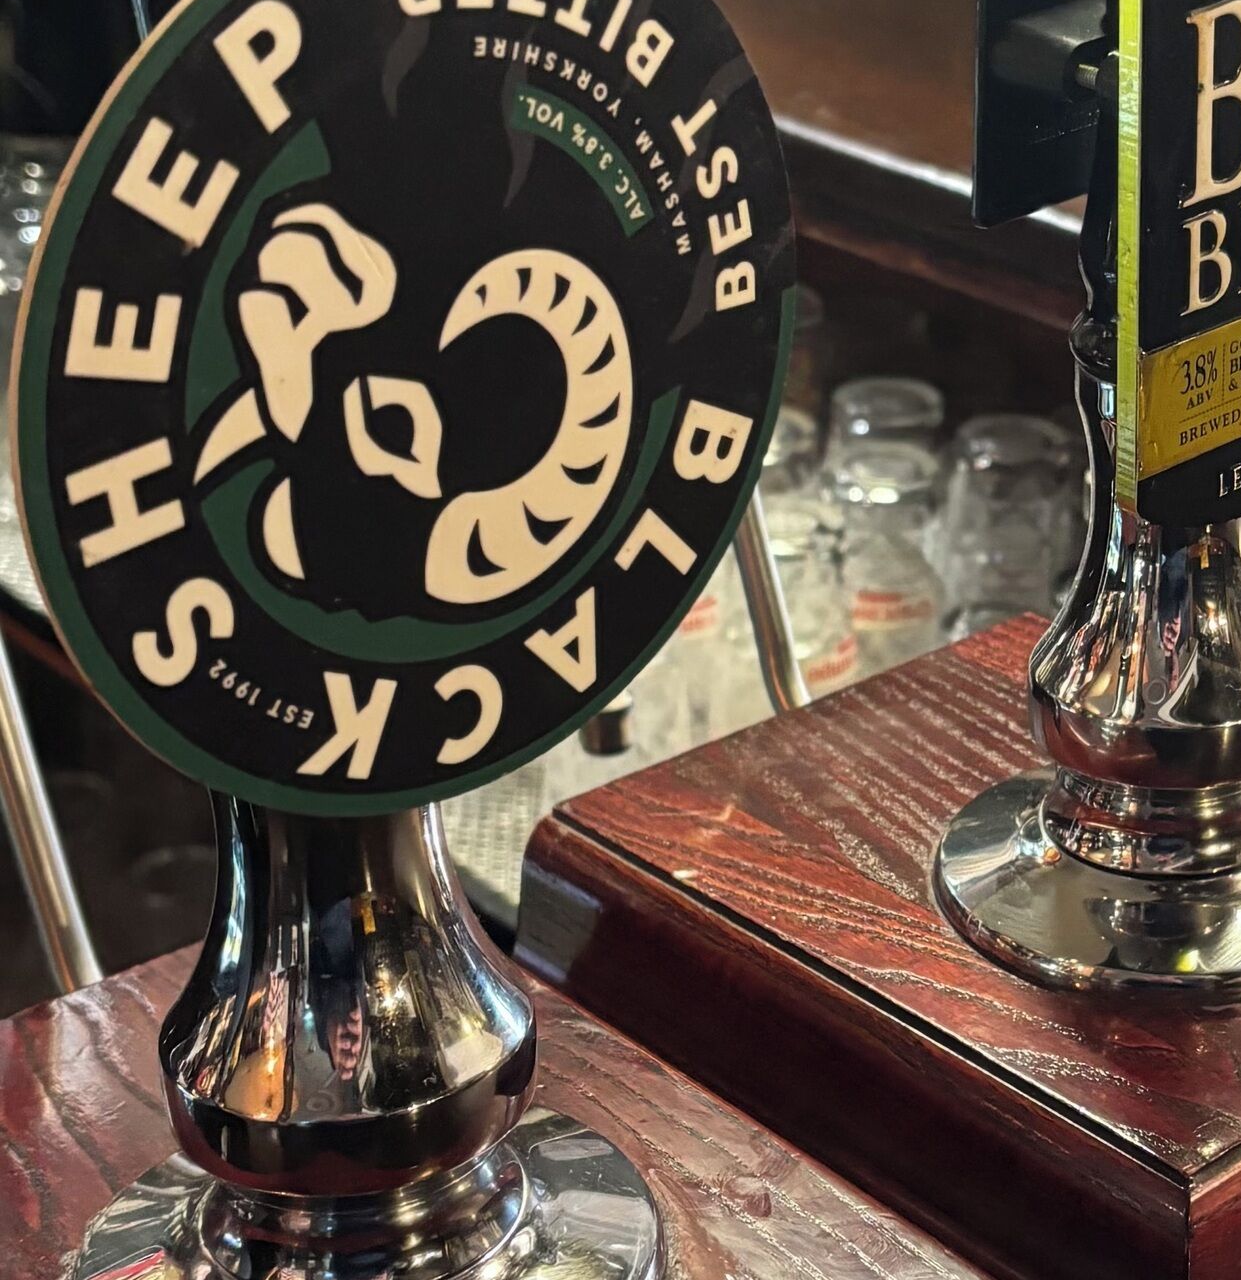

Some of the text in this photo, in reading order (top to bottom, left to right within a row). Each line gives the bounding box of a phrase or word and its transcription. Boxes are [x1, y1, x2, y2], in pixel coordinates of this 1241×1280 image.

[473, 36, 692, 256] MASHAM, YORKSHIRE
[518, 95, 646, 220] ALC. 3.8% VOL.
[671, 97, 756, 312] BEST
[64, 0, 753, 781] BLACK SHEEP
[1180, 346, 1218, 394] 3.8%
[1187, 388, 1213, 410] ABV
[1228, 378, 1238, 392] &
[1179, 408, 1241, 447] BREWED
[209, 659, 315, 729] EST 1992
